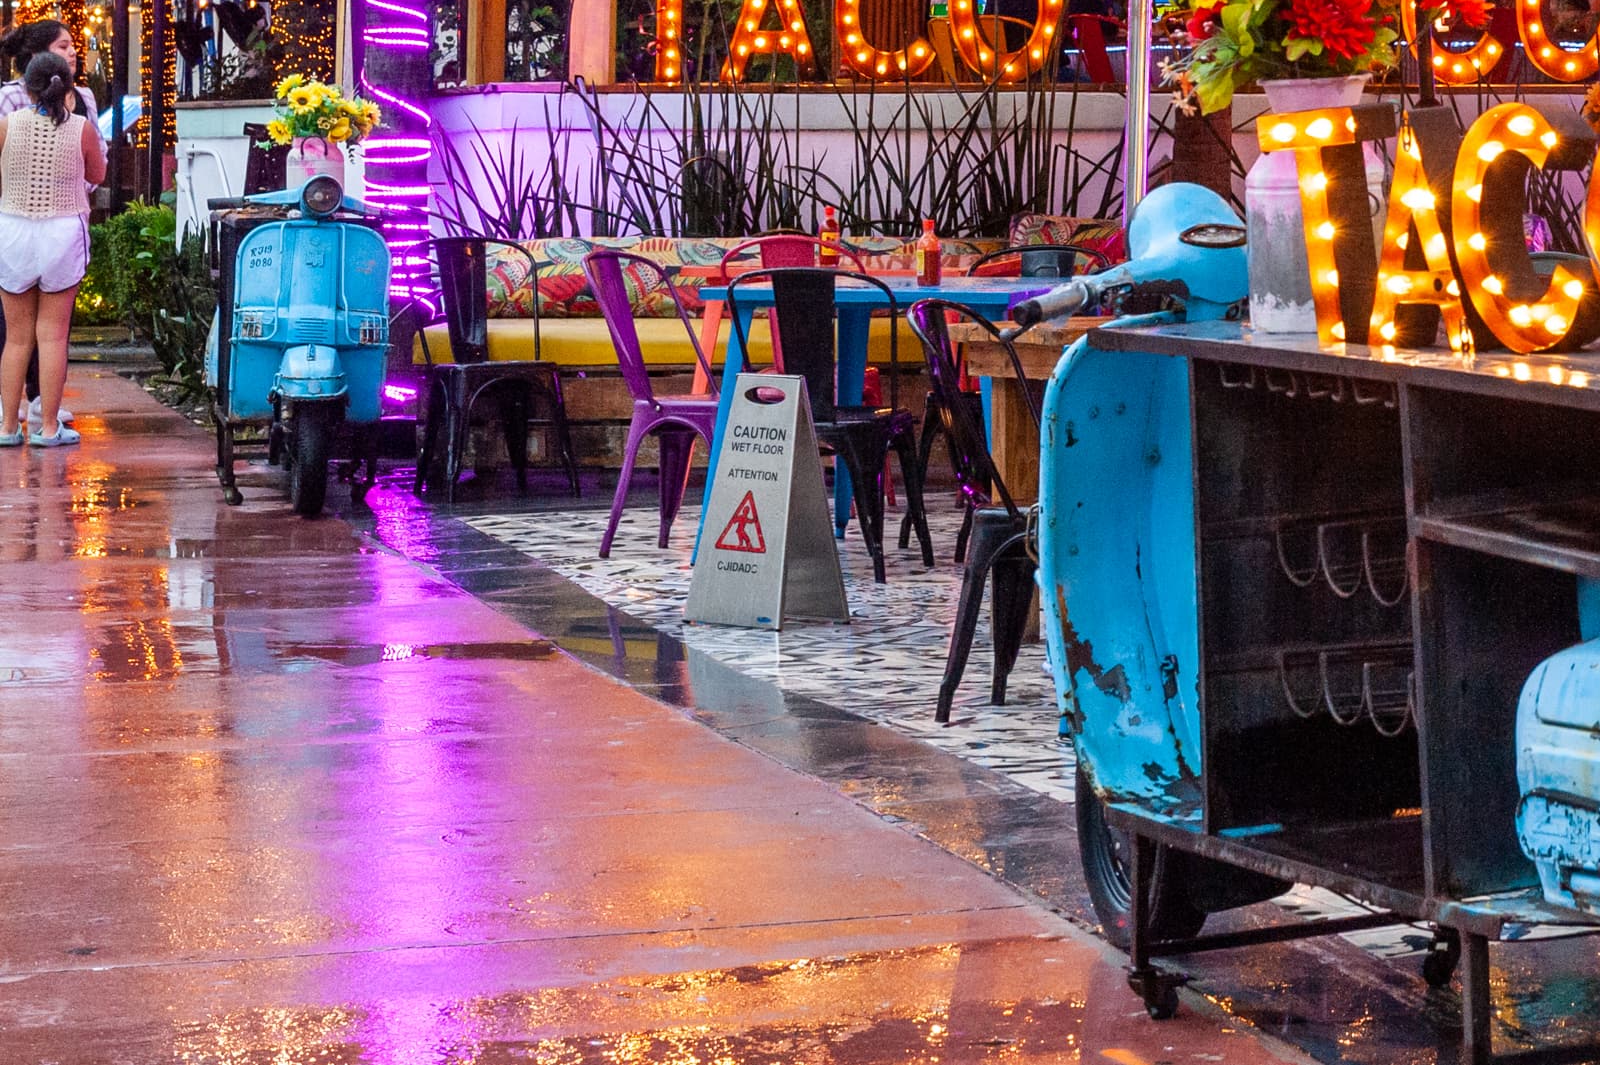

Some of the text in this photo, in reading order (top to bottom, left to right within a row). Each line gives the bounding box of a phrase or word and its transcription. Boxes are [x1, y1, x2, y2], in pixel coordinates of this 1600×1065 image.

[733, 425, 786, 441] CAUTION
[731, 442, 784, 455] WET FLOOR
[728, 468, 778, 482] ATTENTION
